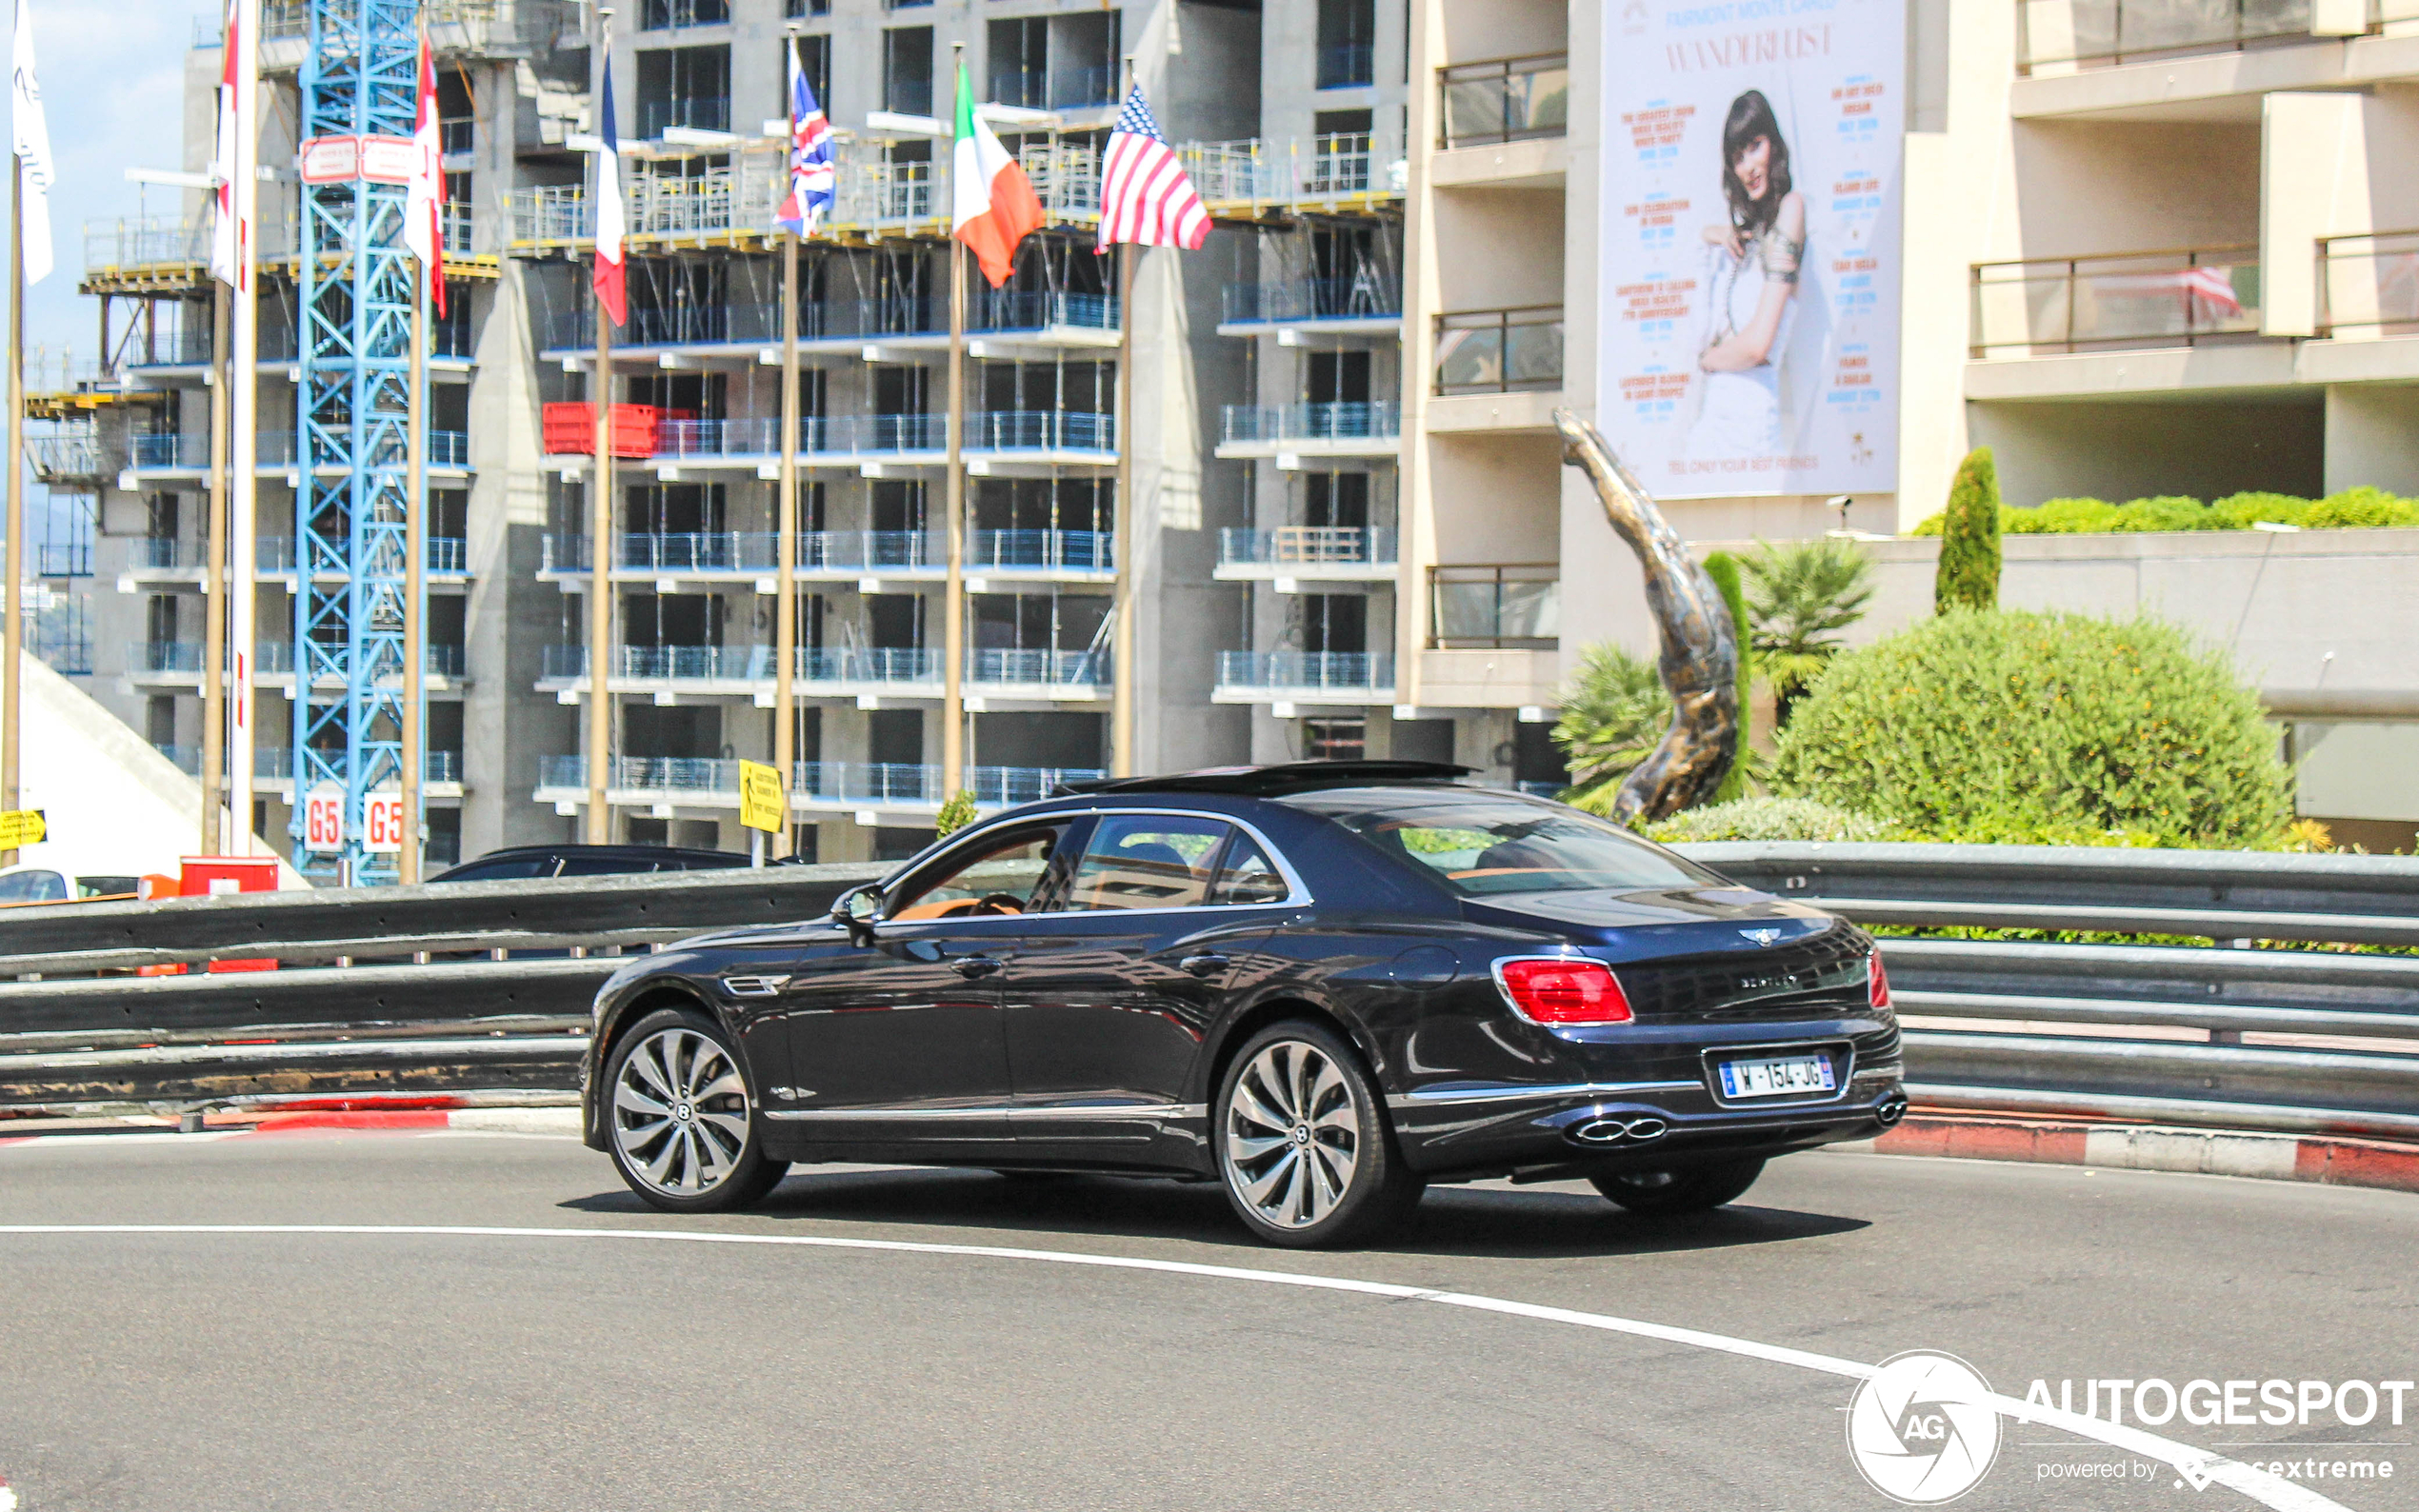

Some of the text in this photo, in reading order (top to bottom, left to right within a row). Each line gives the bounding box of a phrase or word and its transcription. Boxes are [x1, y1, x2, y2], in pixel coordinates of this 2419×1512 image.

[1667, 23, 1832, 70] WANDERLUST
[310, 800, 338, 844] G5
[370, 802, 403, 844] G5
